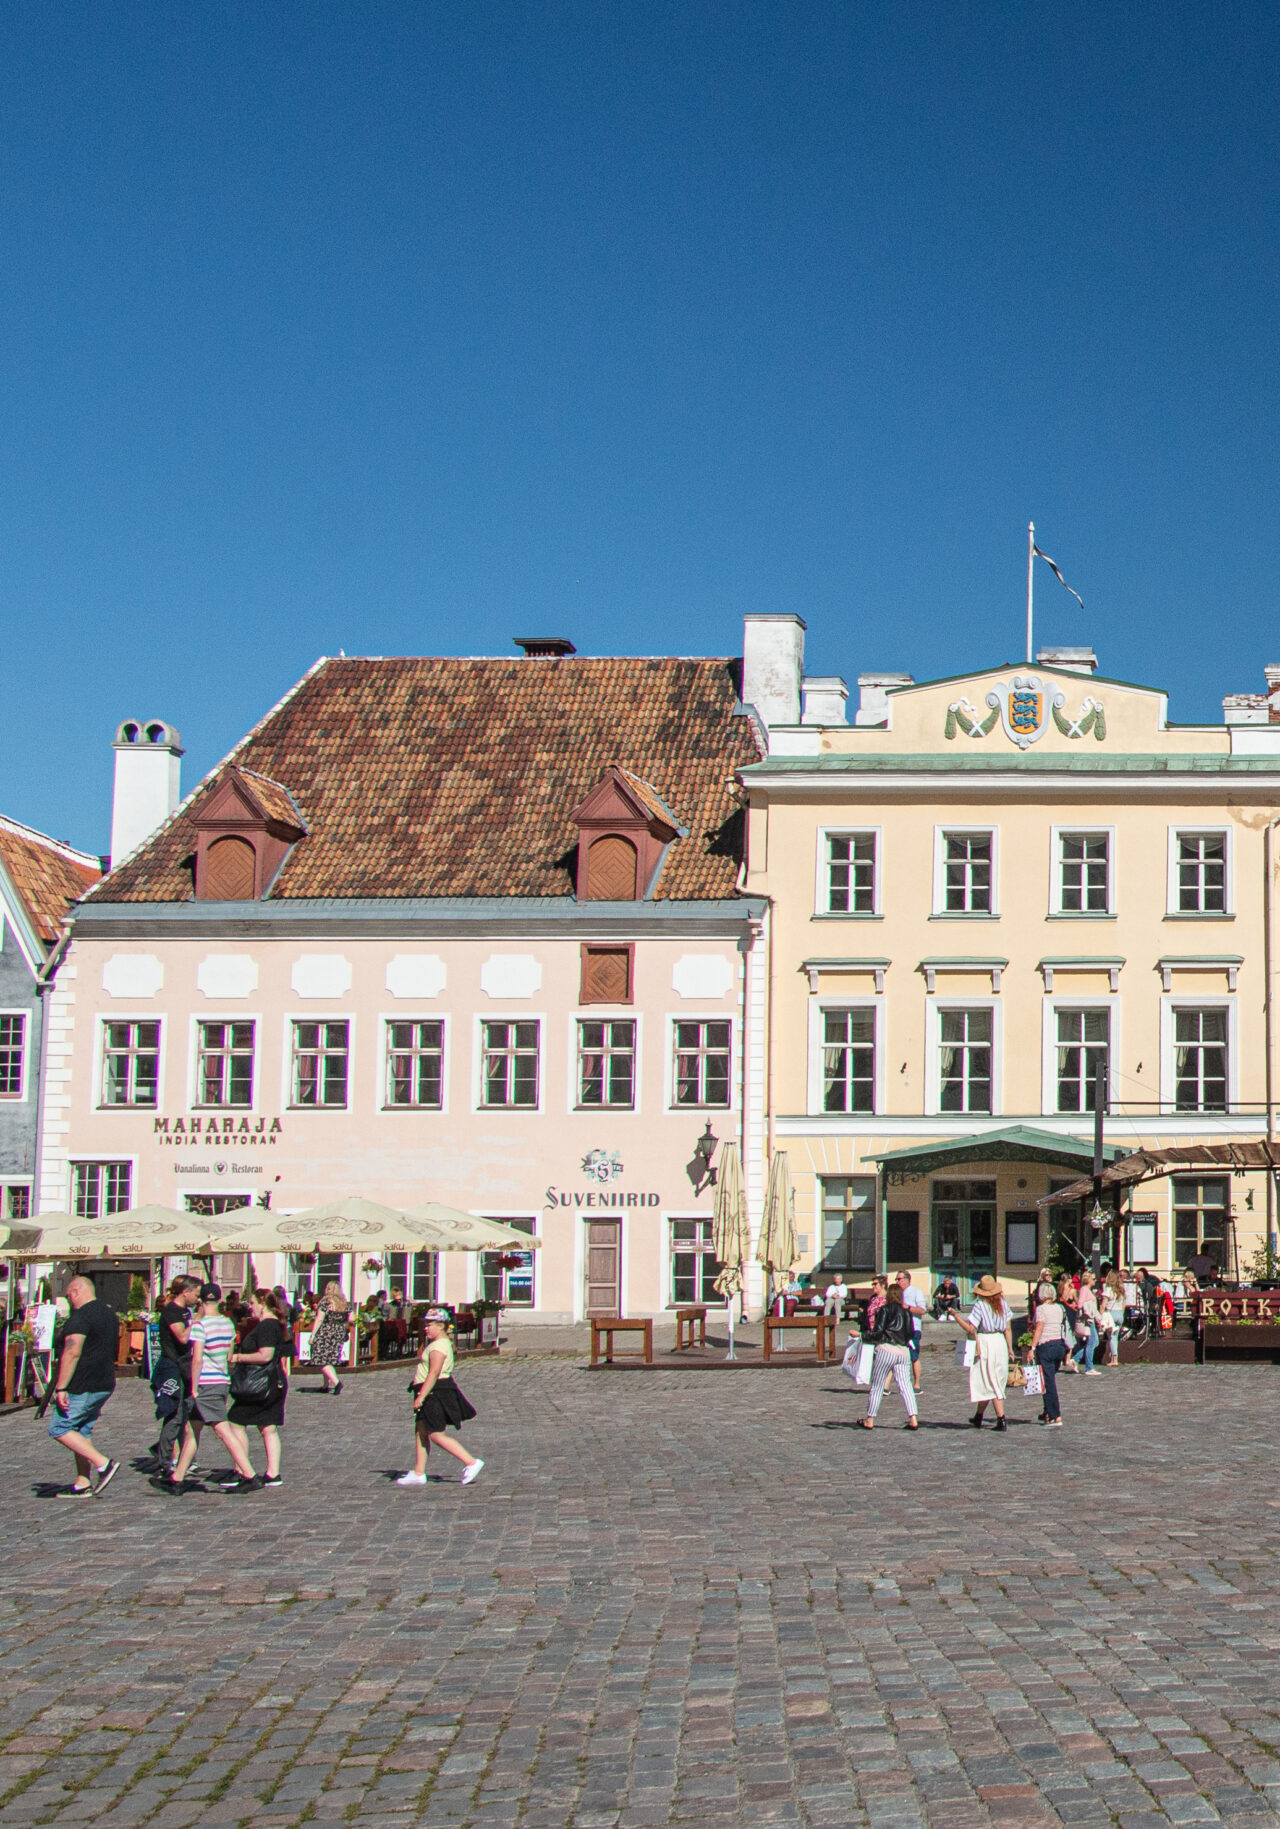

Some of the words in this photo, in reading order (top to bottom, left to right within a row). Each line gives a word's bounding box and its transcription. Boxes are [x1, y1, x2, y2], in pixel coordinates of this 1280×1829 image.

[154, 1117, 282, 1133] MAHARAJA
[159, 1135, 198, 1145] INDIA
[205, 1135, 277, 1145] RESTORAN
[174, 1162, 210, 1174] Vanalinna
[231, 1162, 263, 1174] Restoran
[543, 1186, 661, 1210] SUVENIIRID
